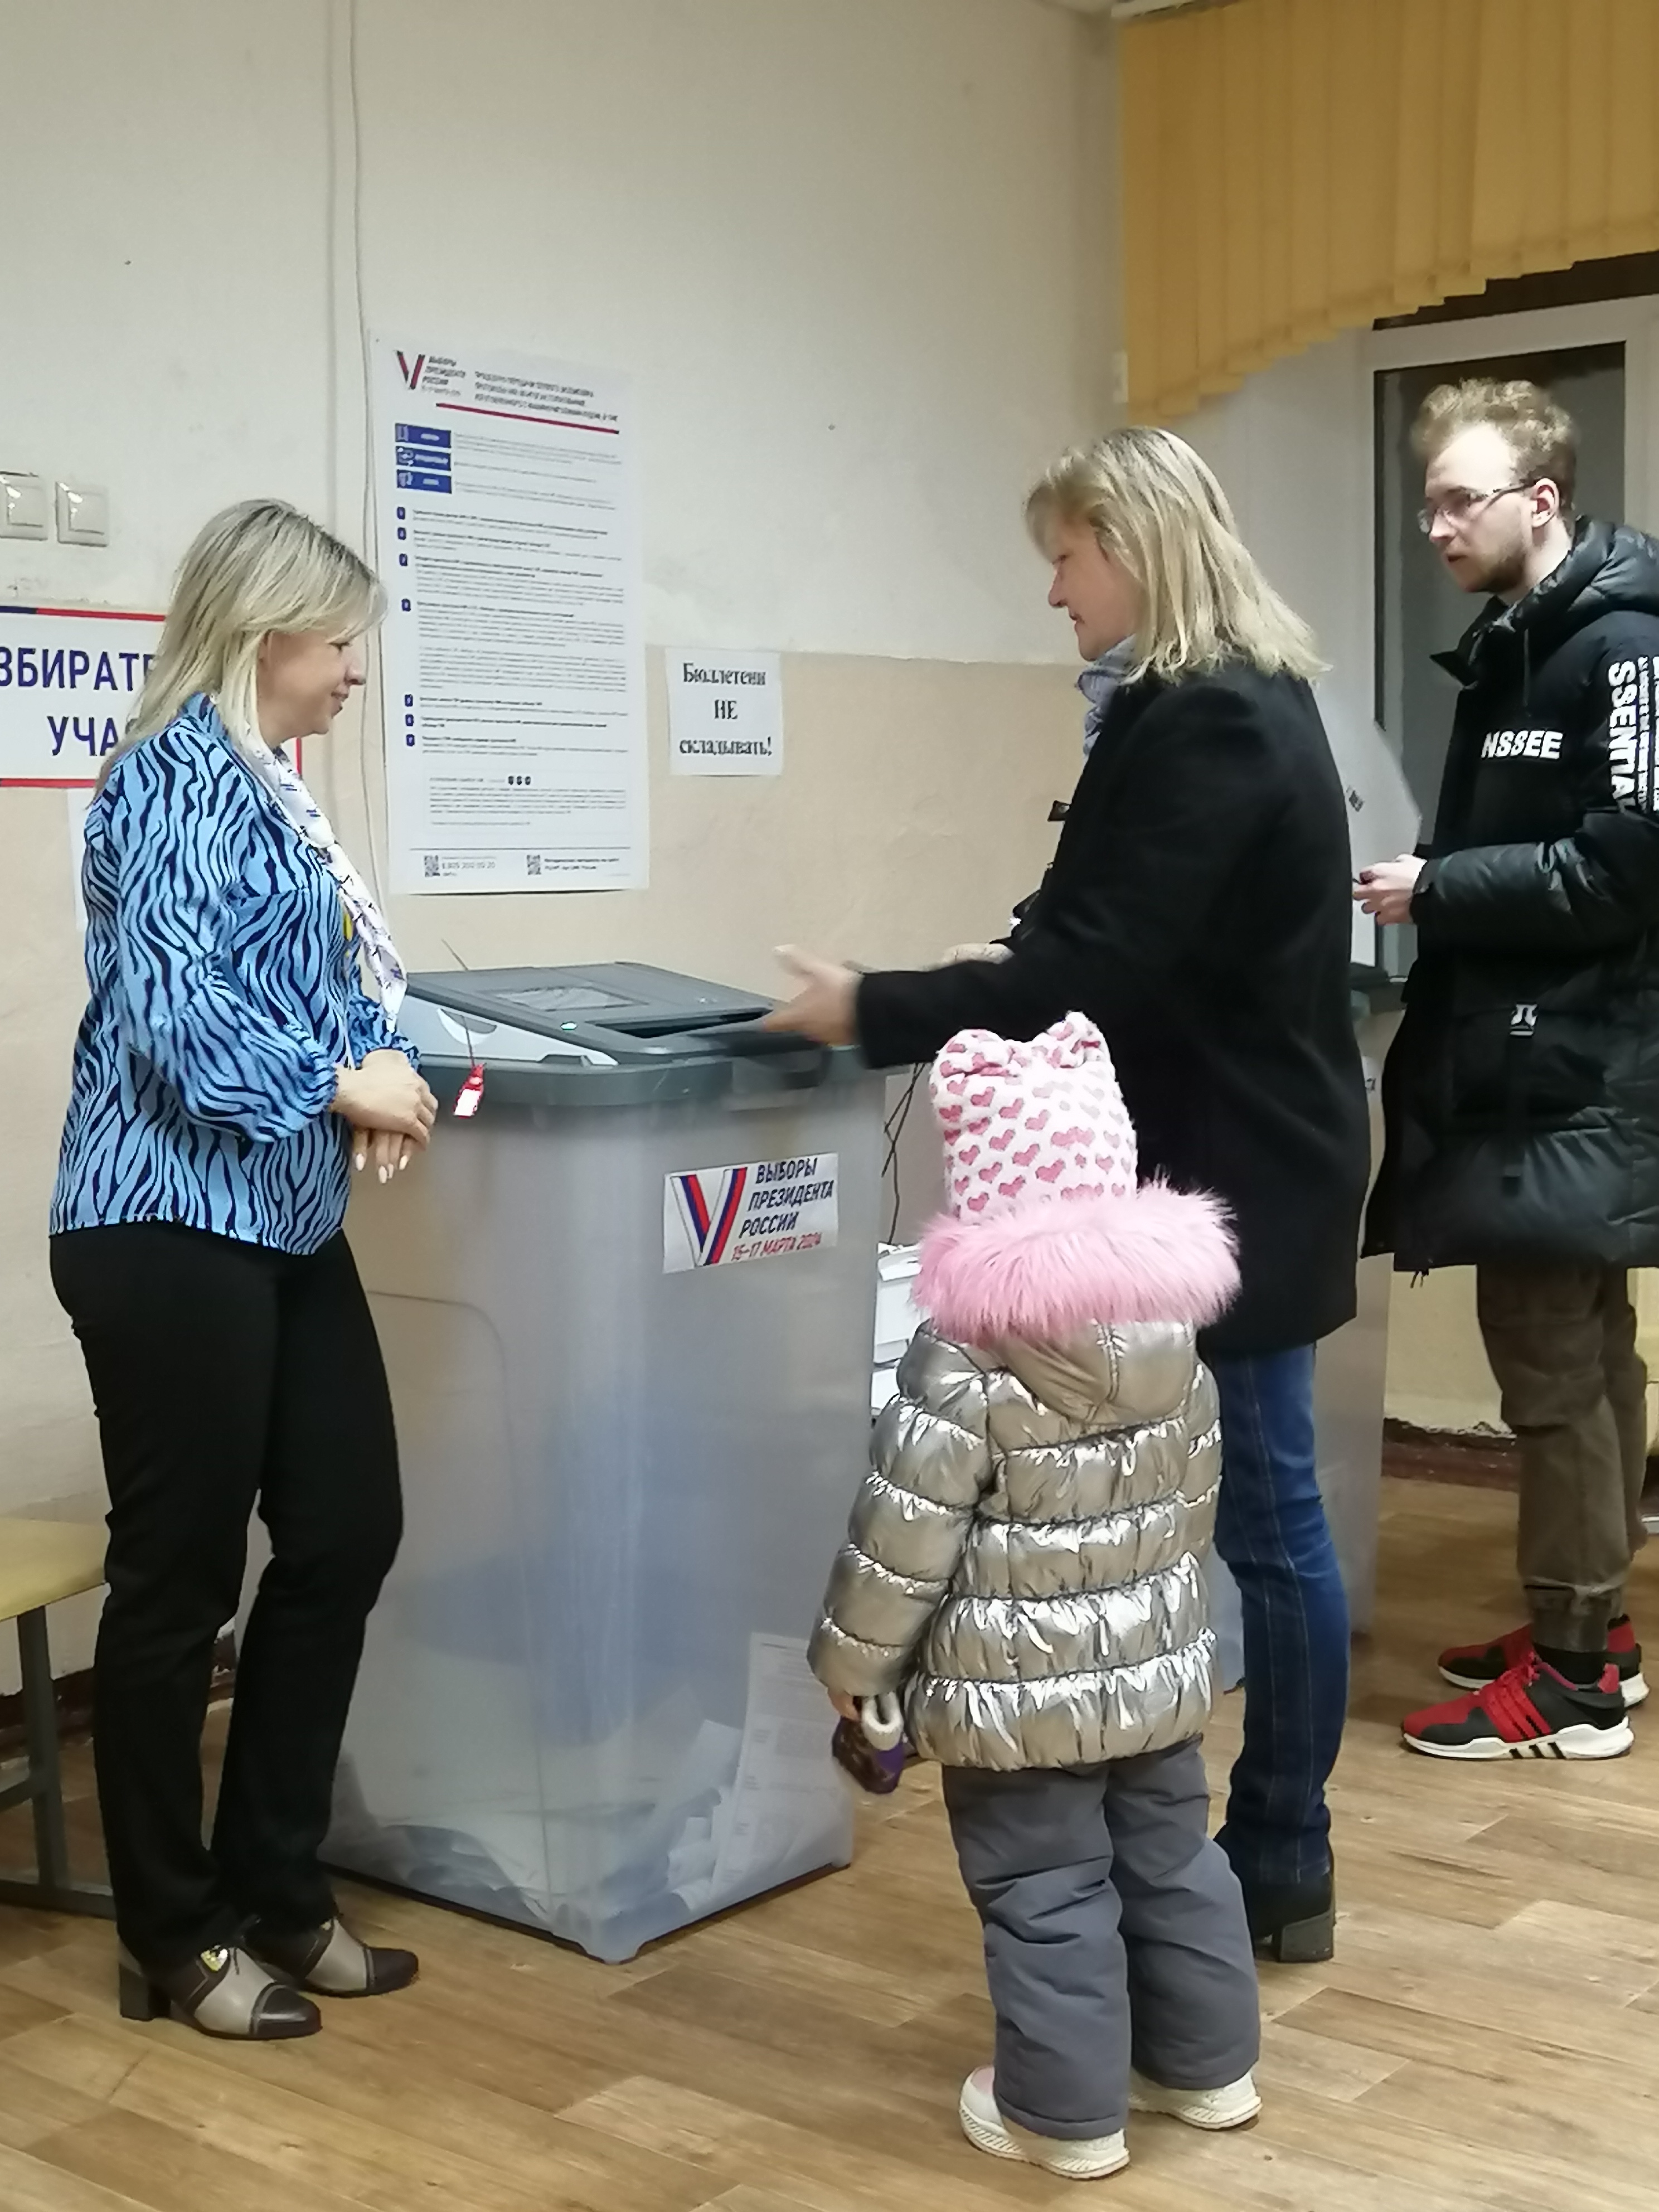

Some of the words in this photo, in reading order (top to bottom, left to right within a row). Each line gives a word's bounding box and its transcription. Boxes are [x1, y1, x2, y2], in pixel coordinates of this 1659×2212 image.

[714, 700, 738, 720] НЕ
[755, 1157, 818, 1184] ВЫБОРЫ
[747, 1180, 835, 1212] ПРЕЗИДЕНТА
[739, 1211, 799, 1239] РОССИИ
